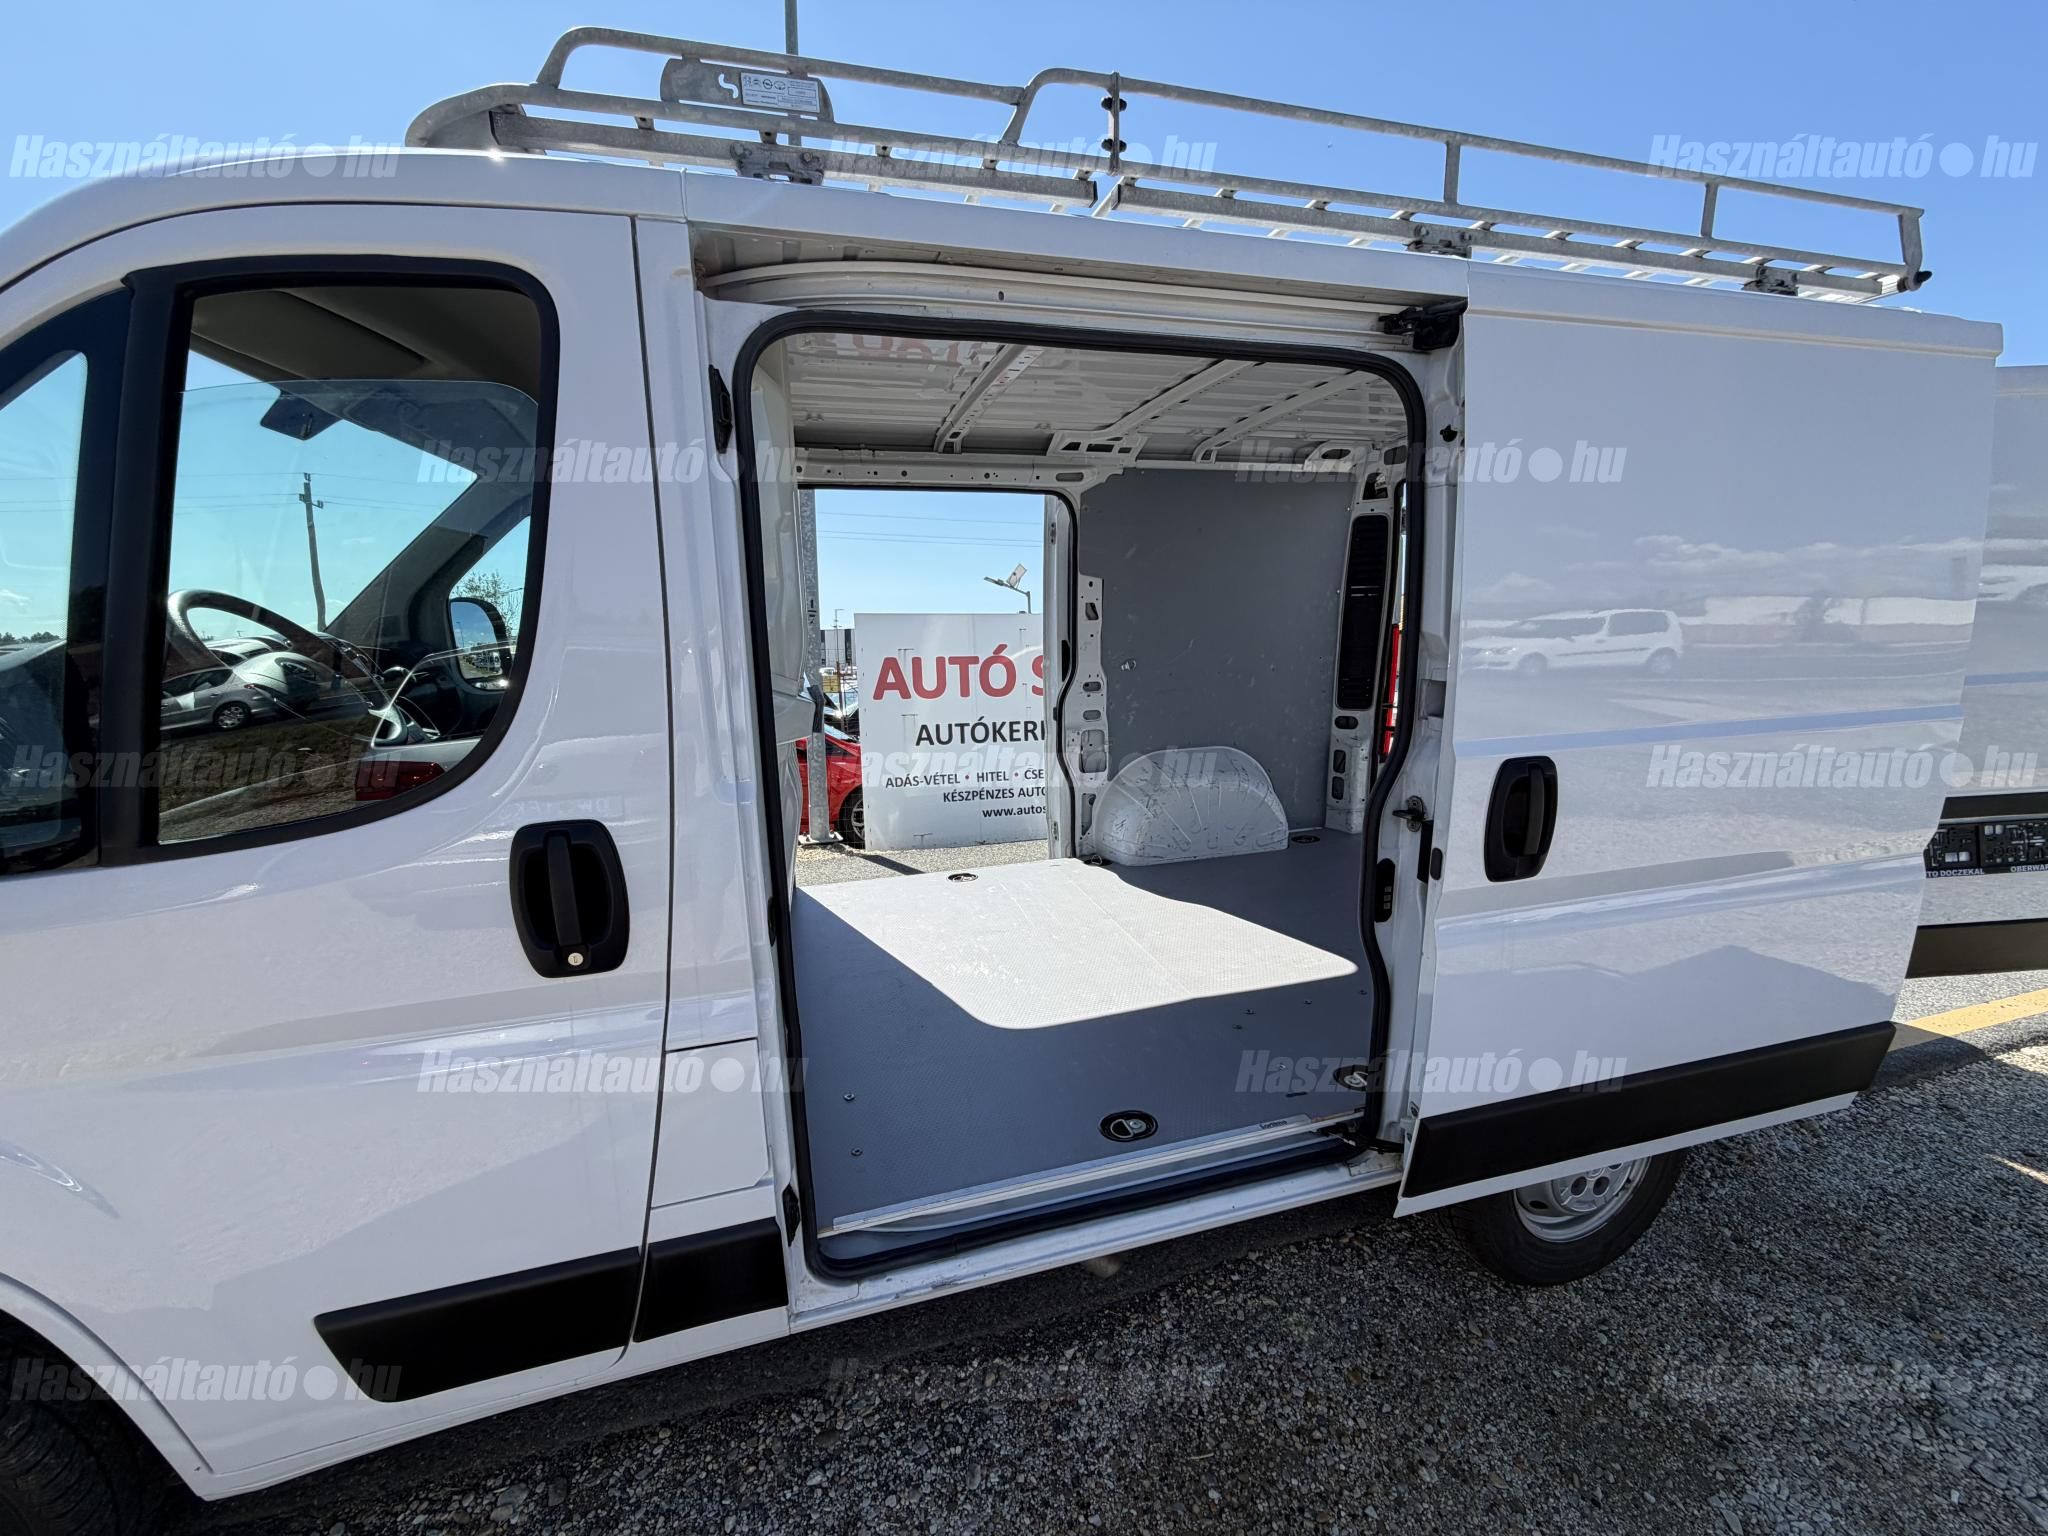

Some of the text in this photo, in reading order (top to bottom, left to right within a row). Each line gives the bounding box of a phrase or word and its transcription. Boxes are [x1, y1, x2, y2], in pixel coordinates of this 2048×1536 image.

[873, 644, 1017, 700] AUTÓ
[885, 772, 960, 788] ADÁS-VÉTEL
[977, 771, 1009, 783] HITEL
[943, 787, 1015, 803] KÉSZPÉNZES
